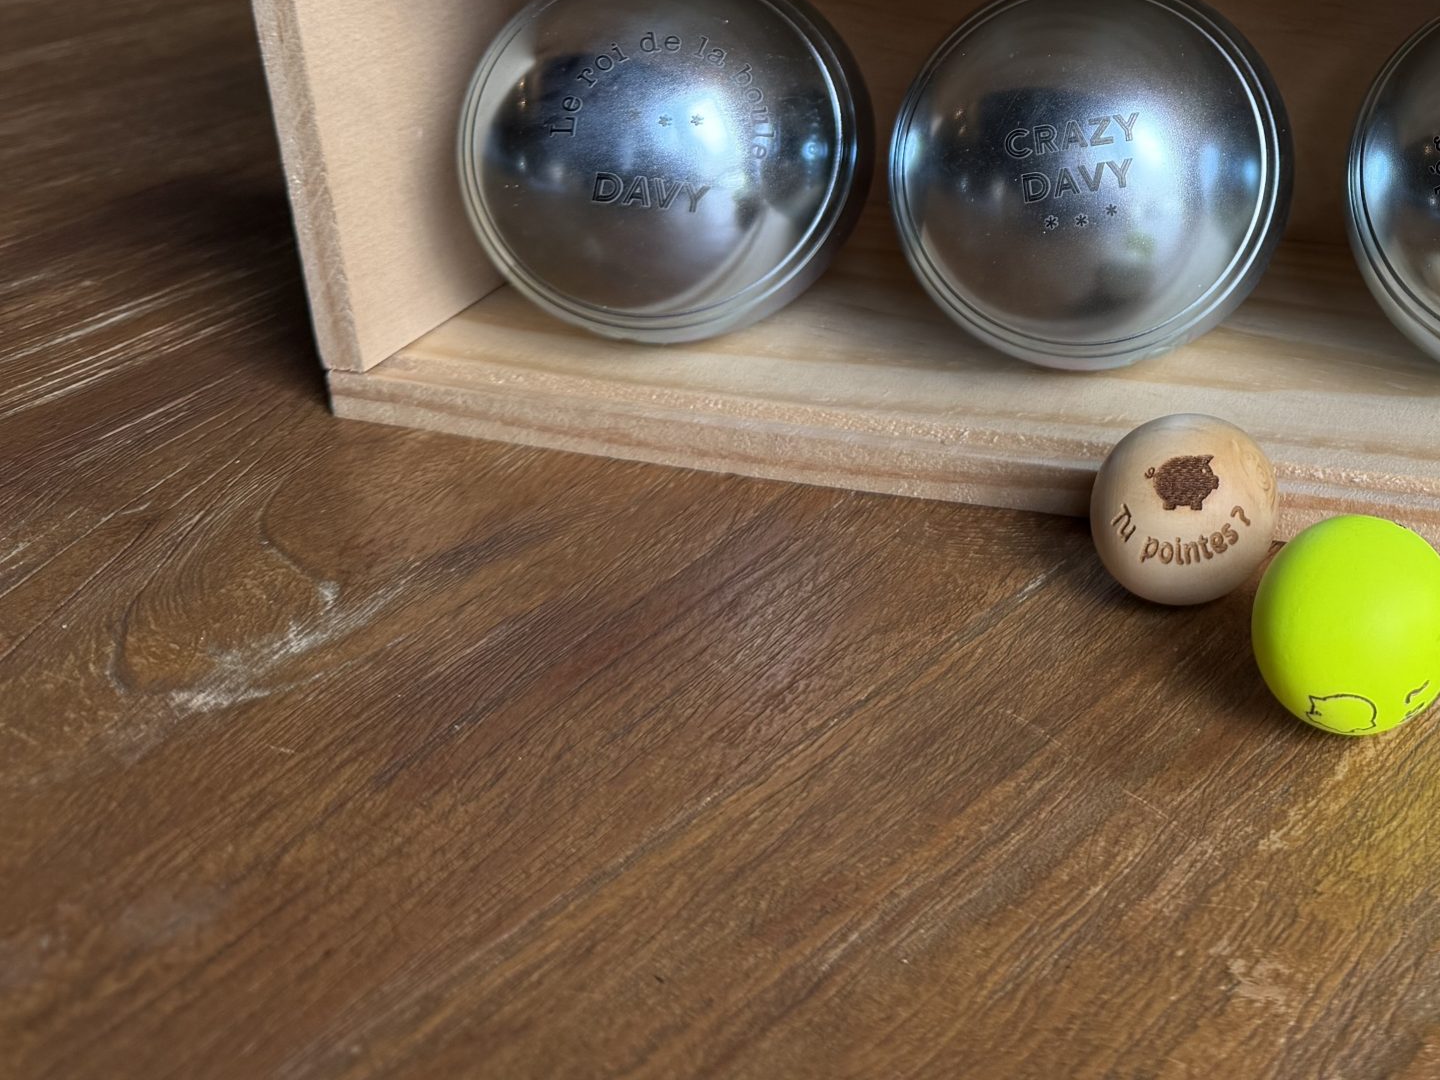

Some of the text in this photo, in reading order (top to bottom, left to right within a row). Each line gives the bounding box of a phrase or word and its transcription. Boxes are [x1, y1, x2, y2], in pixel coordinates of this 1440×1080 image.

[550, 95, 582, 137] Le
[578, 41, 629, 87] roi
[639, 32, 681, 54] de
[698, 37, 726, 67] la
[1004, 112, 1139, 159] CRAZY
[591, 172, 711, 213] DAVY
[1021, 157, 1133, 203] DAVY
[1112, 504, 1137, 542] Tu
[1141, 523, 1239, 565] pointes
